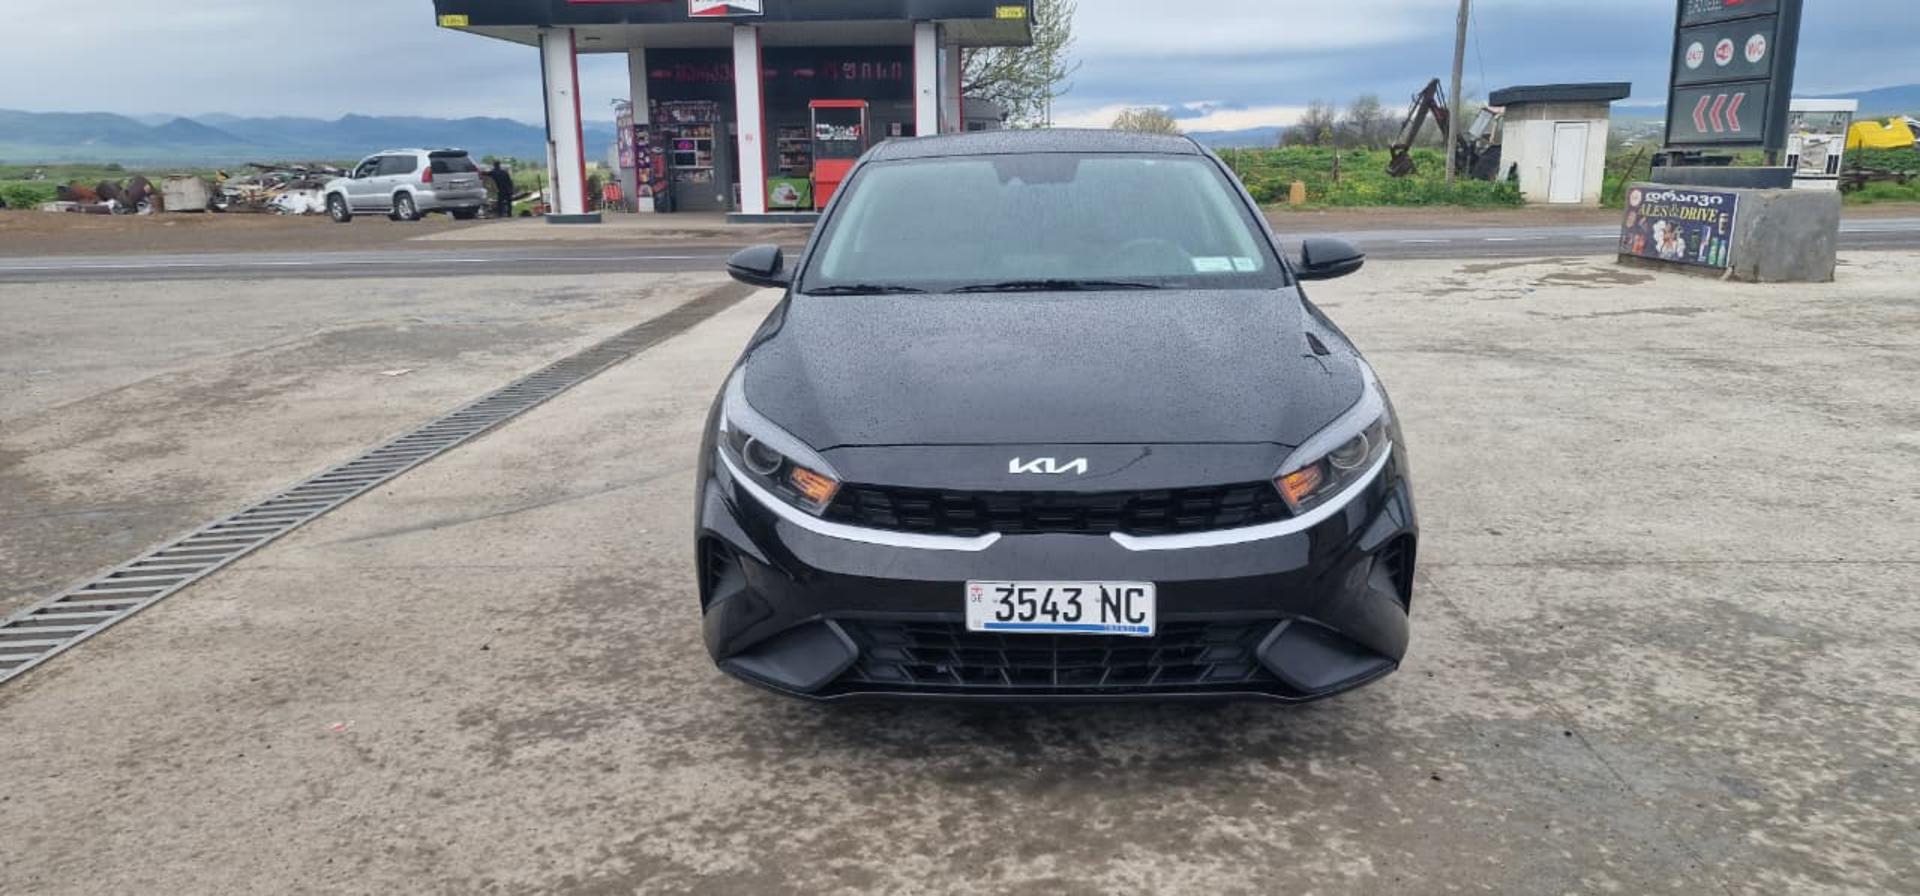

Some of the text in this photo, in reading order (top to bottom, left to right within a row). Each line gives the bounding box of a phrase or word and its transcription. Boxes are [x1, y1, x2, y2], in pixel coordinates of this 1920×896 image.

[1748, 39, 1764, 57] WC
[1645, 189, 1723, 206] დრაივი
[1680, 206, 1719, 223] DRIVE
[1009, 457, 1087, 475] KIA
[995, 587, 1146, 623] 3543 NC
